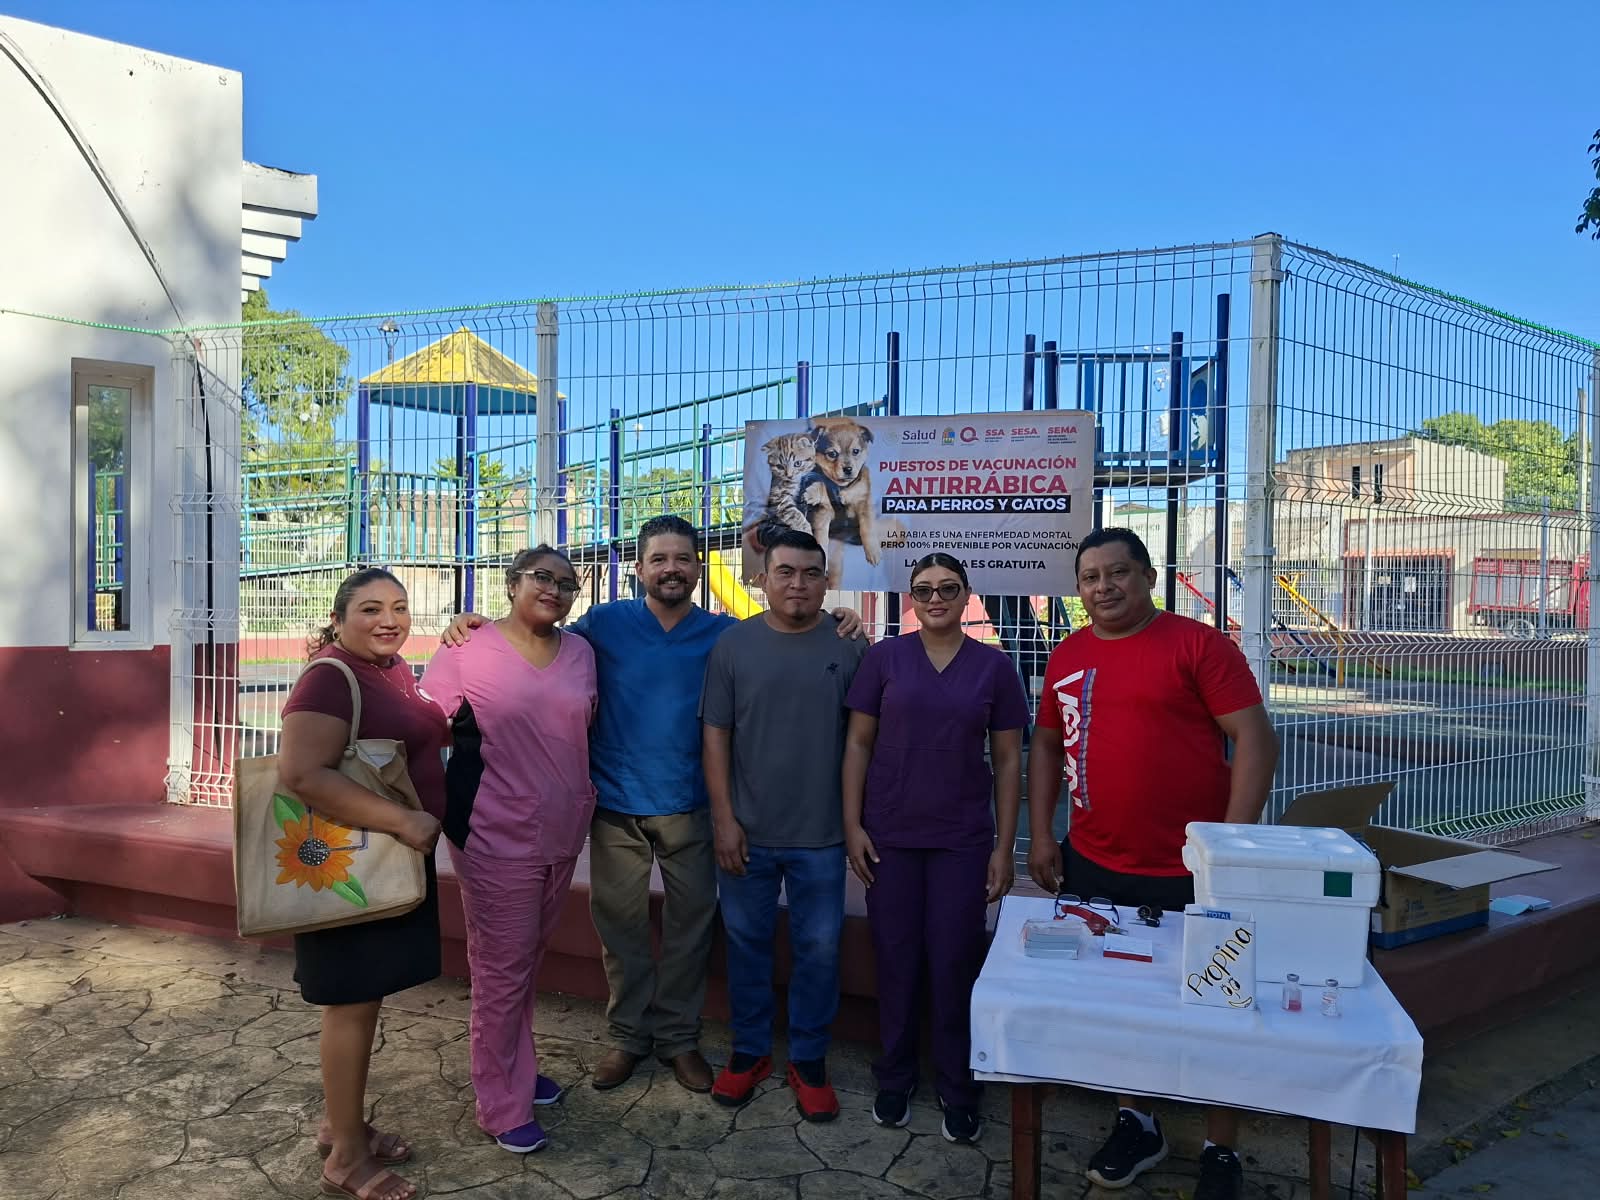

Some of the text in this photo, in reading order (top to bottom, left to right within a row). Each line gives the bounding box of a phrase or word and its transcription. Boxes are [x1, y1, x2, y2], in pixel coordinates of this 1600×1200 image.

[903, 429, 936, 440] Salud
[1010, 427, 1038, 435] SESA
[1047, 426, 1078, 434] SEMA
[880, 455, 1077, 472] PUESTOS DE VACUNACIÓN
[886, 471, 1067, 495] ANTIRRÁBICA
[886, 498, 1067, 511] PARA PERROS Y GATOS
[900, 531, 928, 539] RABIA
[929, 531, 941, 539] ES
[942, 531, 963, 539] UNA
[964, 531, 1031, 539] ENFERMEDAD
[1032, 531, 1073, 539] MORTAL
[880, 541, 905, 549] PERO
[906, 541, 931, 549] 100%
[932, 541, 990, 549] PREVENIBLE
[992, 541, 1012, 549] POR
[904, 559, 918, 568] LA
[970, 560, 986, 569] ES
[987, 560, 1047, 569] GRATUITA
[1208, 911, 1230, 919] TOTAL
[1187, 927, 1253, 997] Propina
